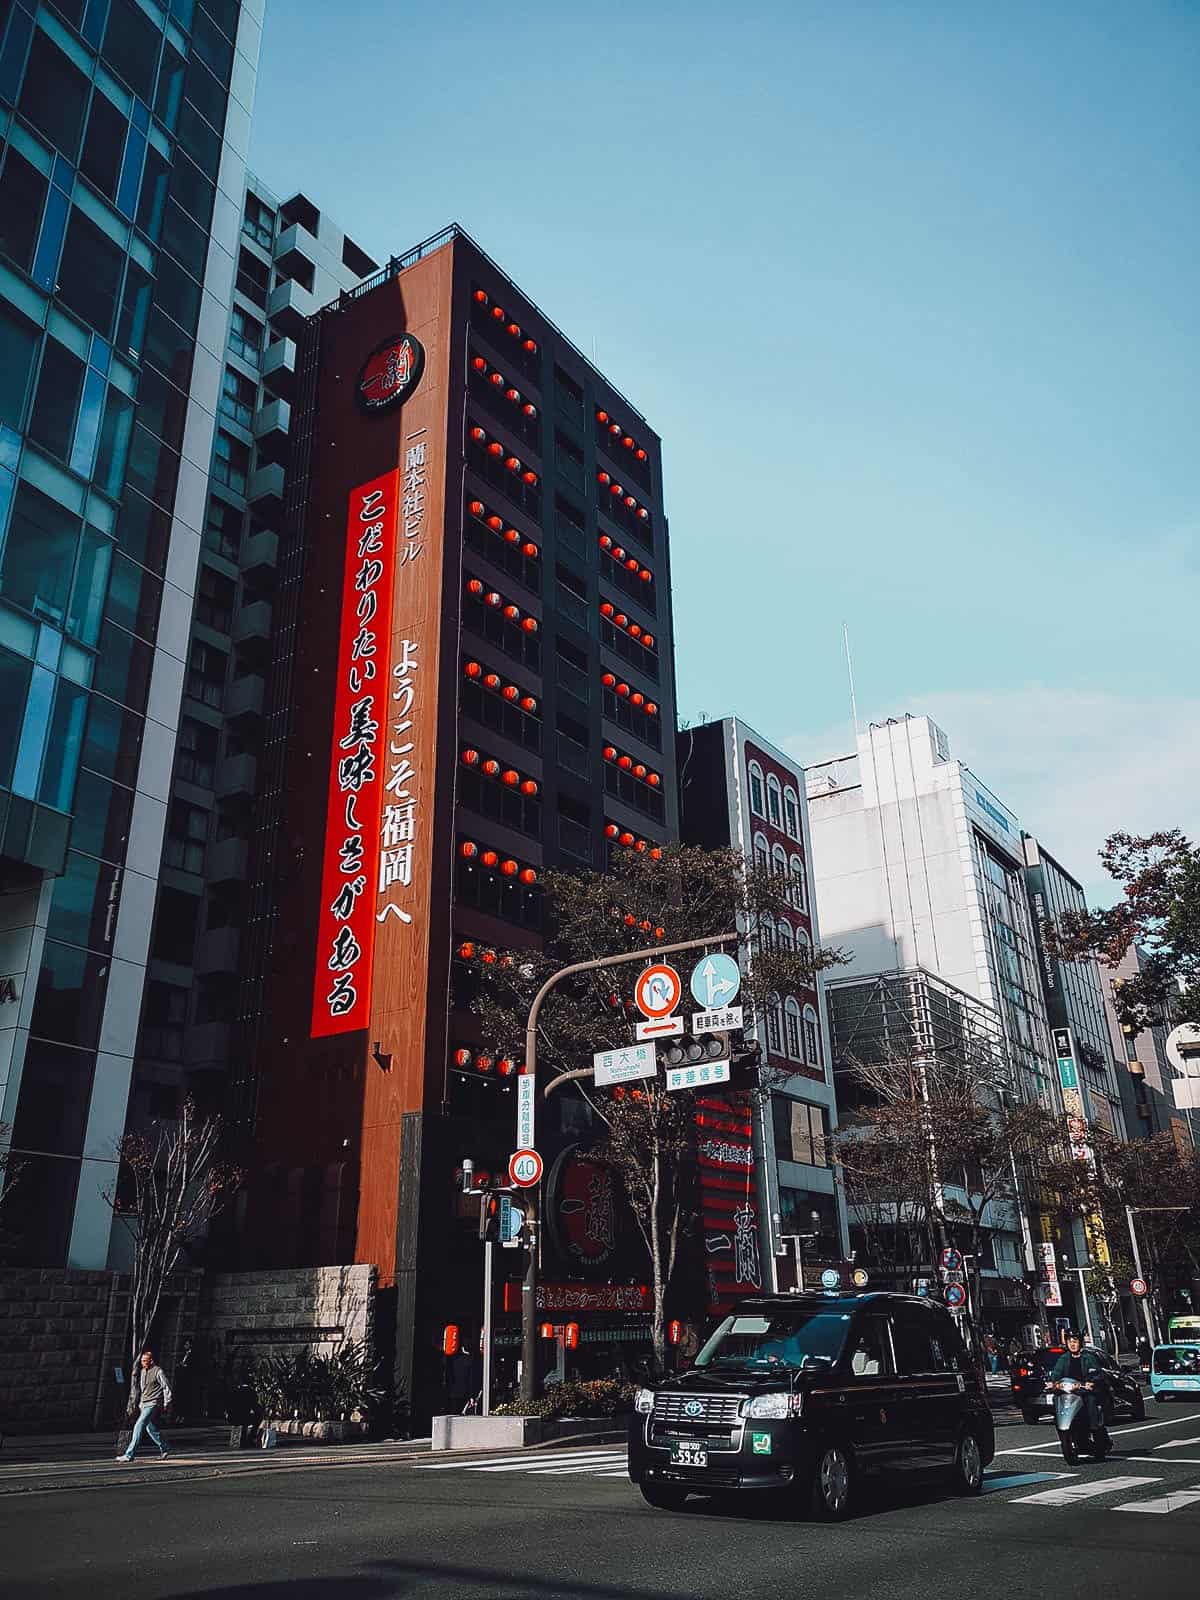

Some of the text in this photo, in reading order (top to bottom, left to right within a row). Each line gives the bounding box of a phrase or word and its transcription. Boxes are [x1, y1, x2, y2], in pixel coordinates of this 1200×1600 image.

[400, 425, 427, 568] 一蘭本社ビル
[327, 489, 386, 1017] こだわりたい美味しさがある
[375, 638, 419, 925] ようこそ福岡へ
[602, 1047, 648, 1067] 西大橋
[516, 1159, 535, 1177] 40
